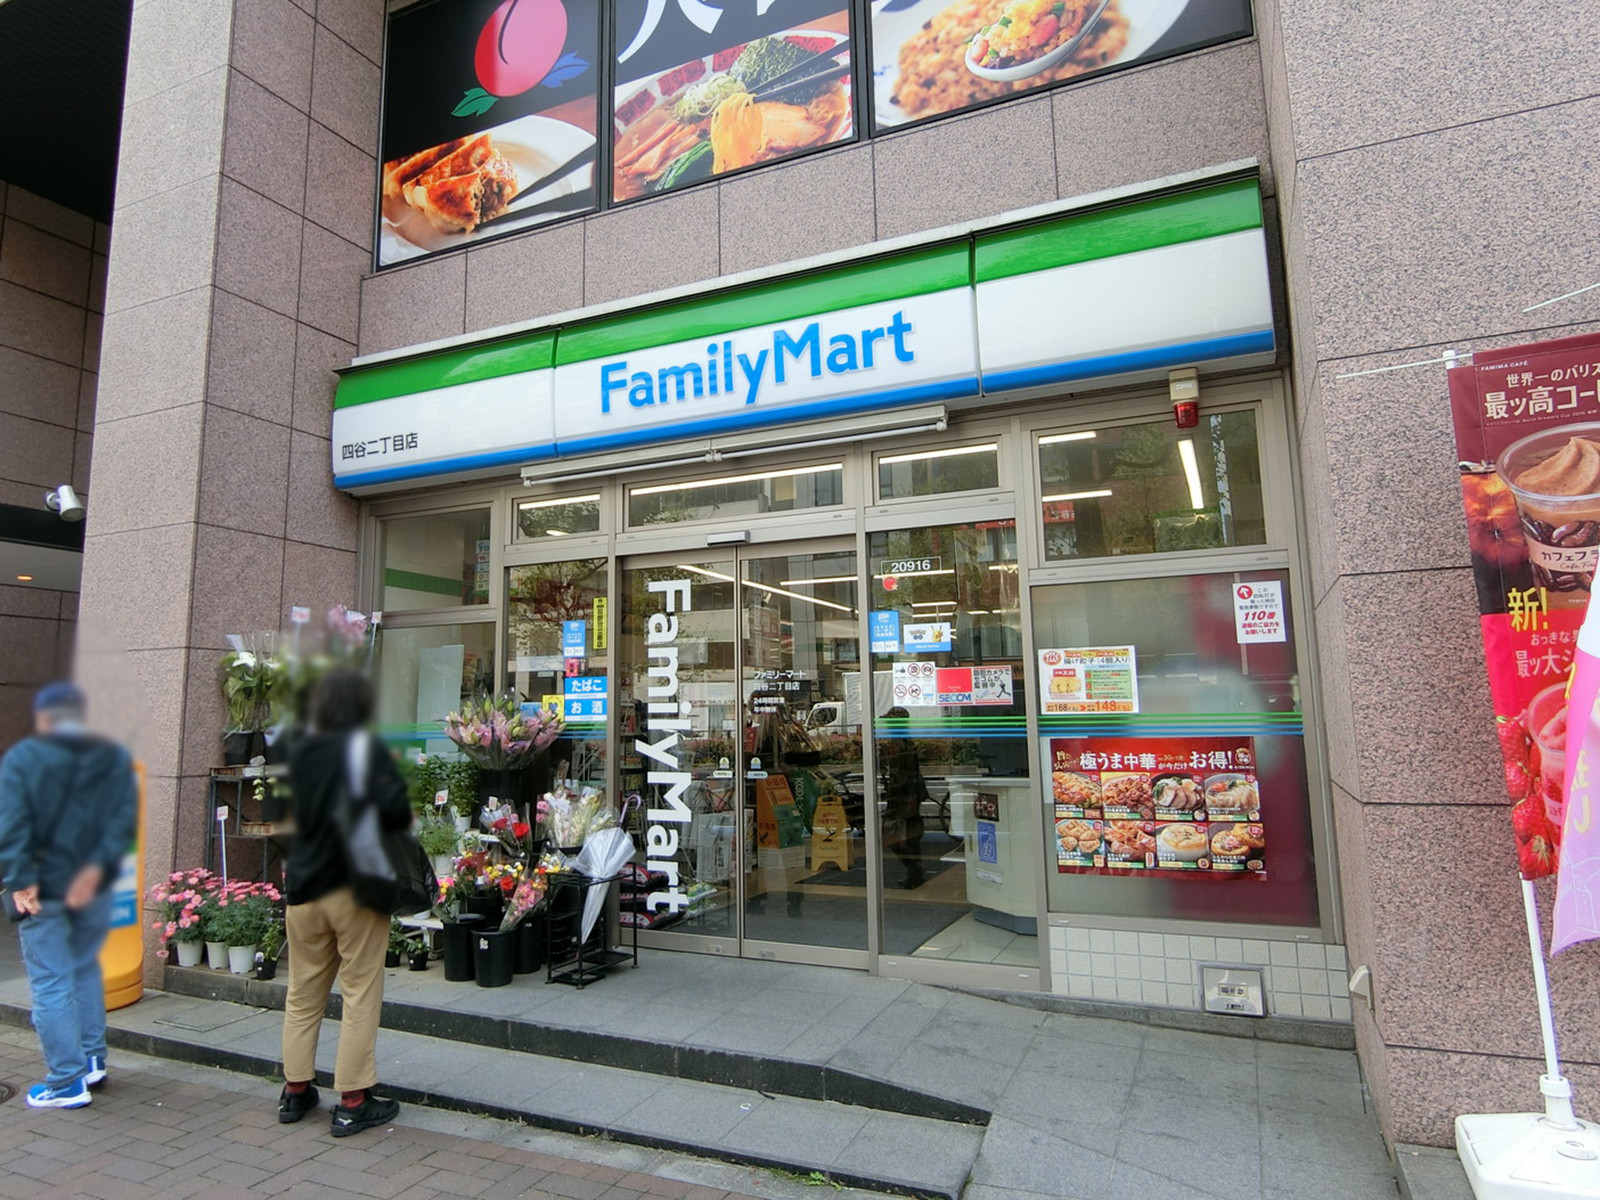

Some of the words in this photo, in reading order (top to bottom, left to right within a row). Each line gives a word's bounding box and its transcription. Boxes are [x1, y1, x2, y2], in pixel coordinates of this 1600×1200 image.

[601, 310, 916, 413] FamilyMart
[1481, 363, 1509, 371] FAMIMA
[1484, 379, 1600, 420] 最ッ高コー
[342, 432, 419, 460] 四谷二丁目店
[891, 559, 931, 573] 20916
[1244, 610, 1276, 621] 110番
[1507, 586, 1549, 632] 新!
[753, 669, 806, 679] ファミリーマート
[973, 668, 1010, 676] 防犯カメラで
[571, 679, 602, 692] たばこ
[939, 693, 972, 703] SECOM
[1095, 700, 1117, 711] 148
[635, 578, 692, 914] FamilyMart
[1080, 751, 1156, 770] 極うま中華
[1189, 750, 1233, 770] お得!
